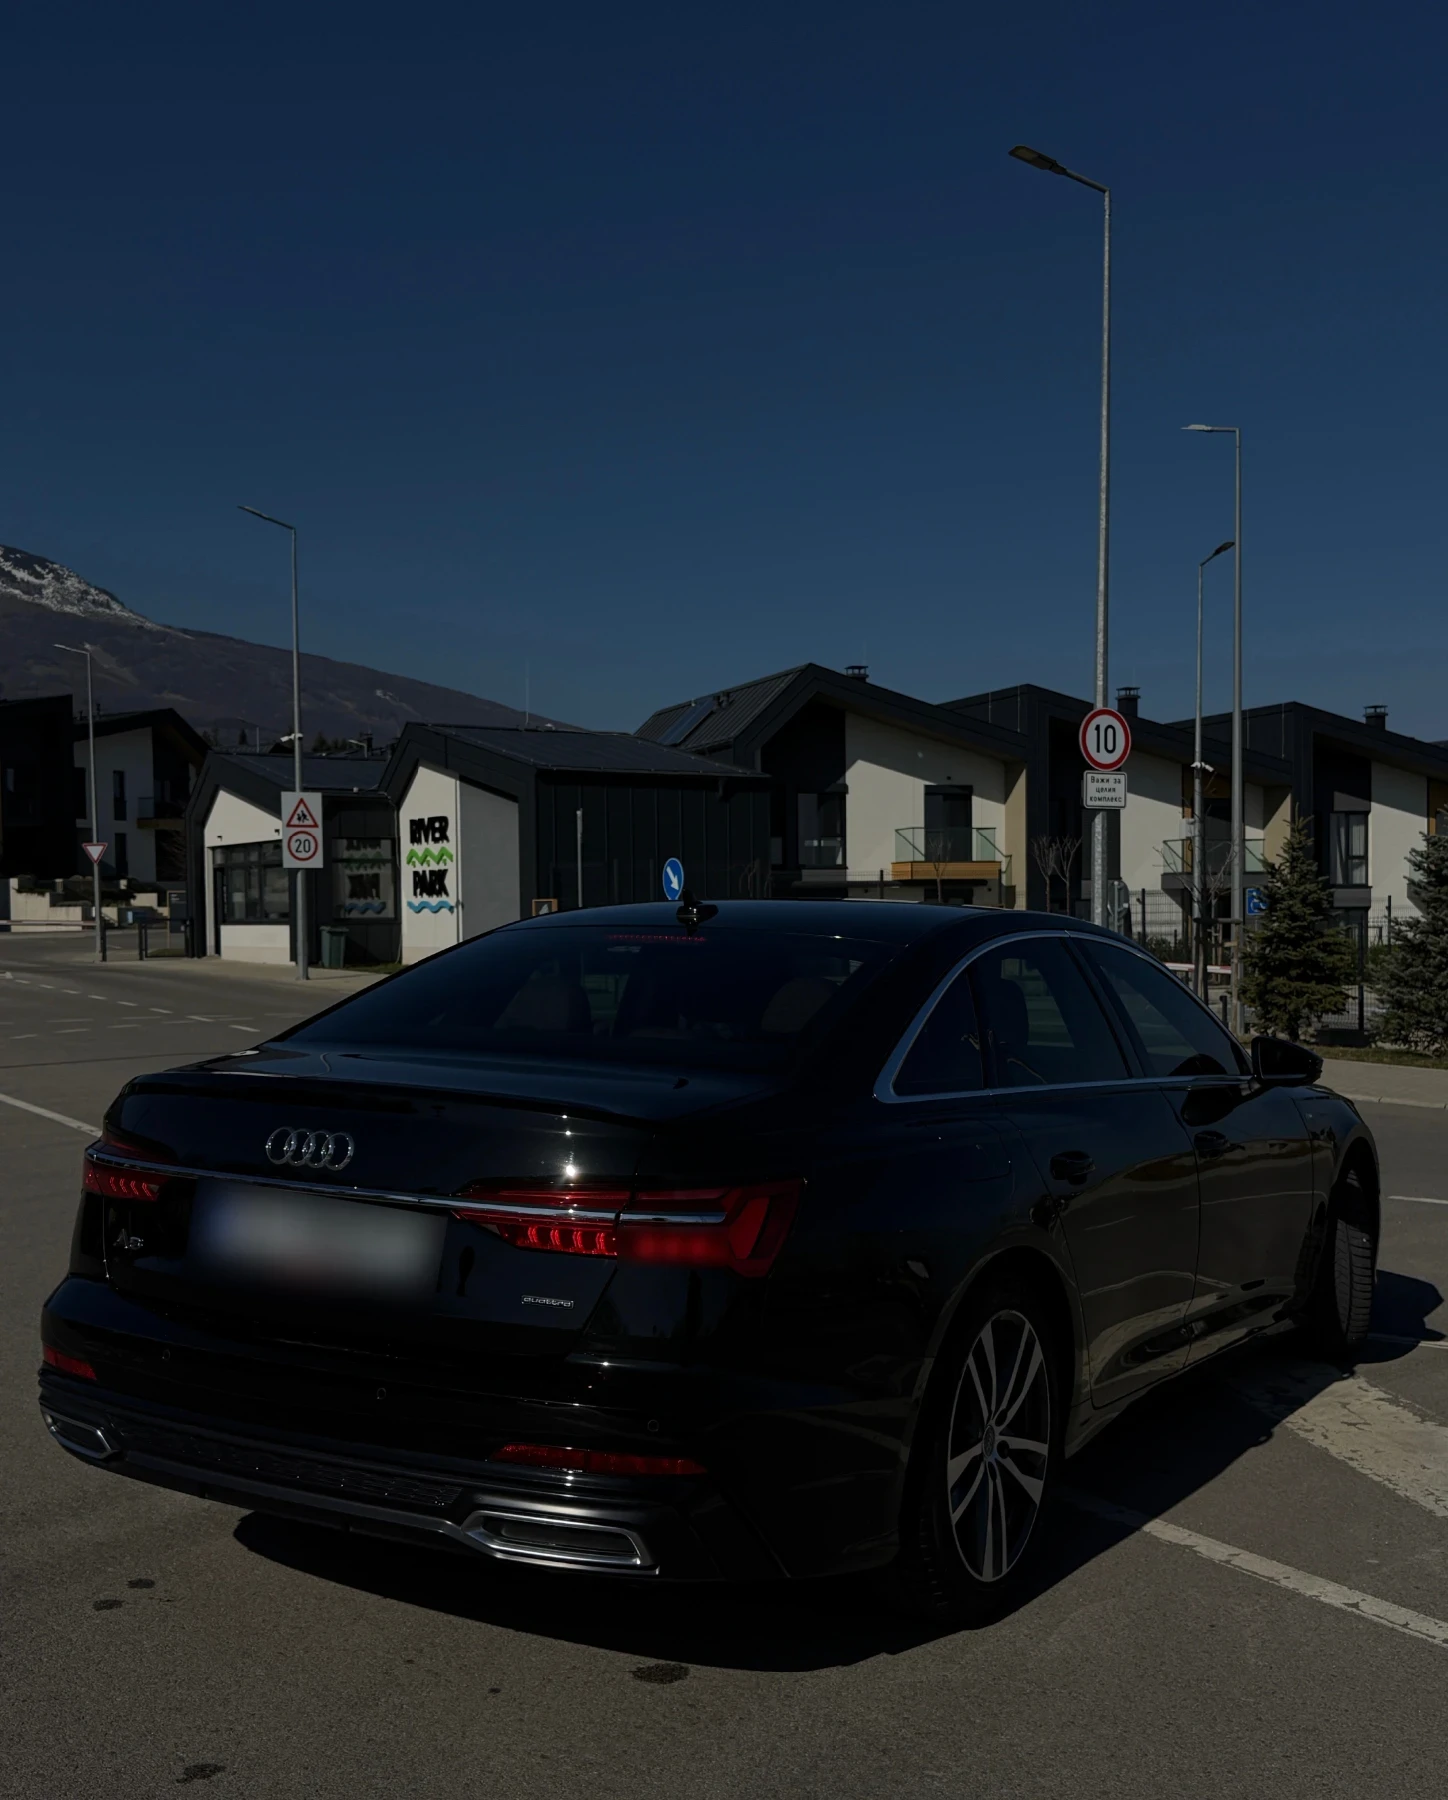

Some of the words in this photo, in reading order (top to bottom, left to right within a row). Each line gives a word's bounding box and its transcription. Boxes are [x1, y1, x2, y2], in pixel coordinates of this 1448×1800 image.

[1095, 725, 1116, 754] 10
[1091, 776, 1110, 784] Важи
[410, 816, 450, 845] RIVER
[295, 839, 311, 853] 20
[413, 869, 449, 897] PARK
[112, 1228, 145, 1251] A6
[523, 1297, 571, 1308] quattro
